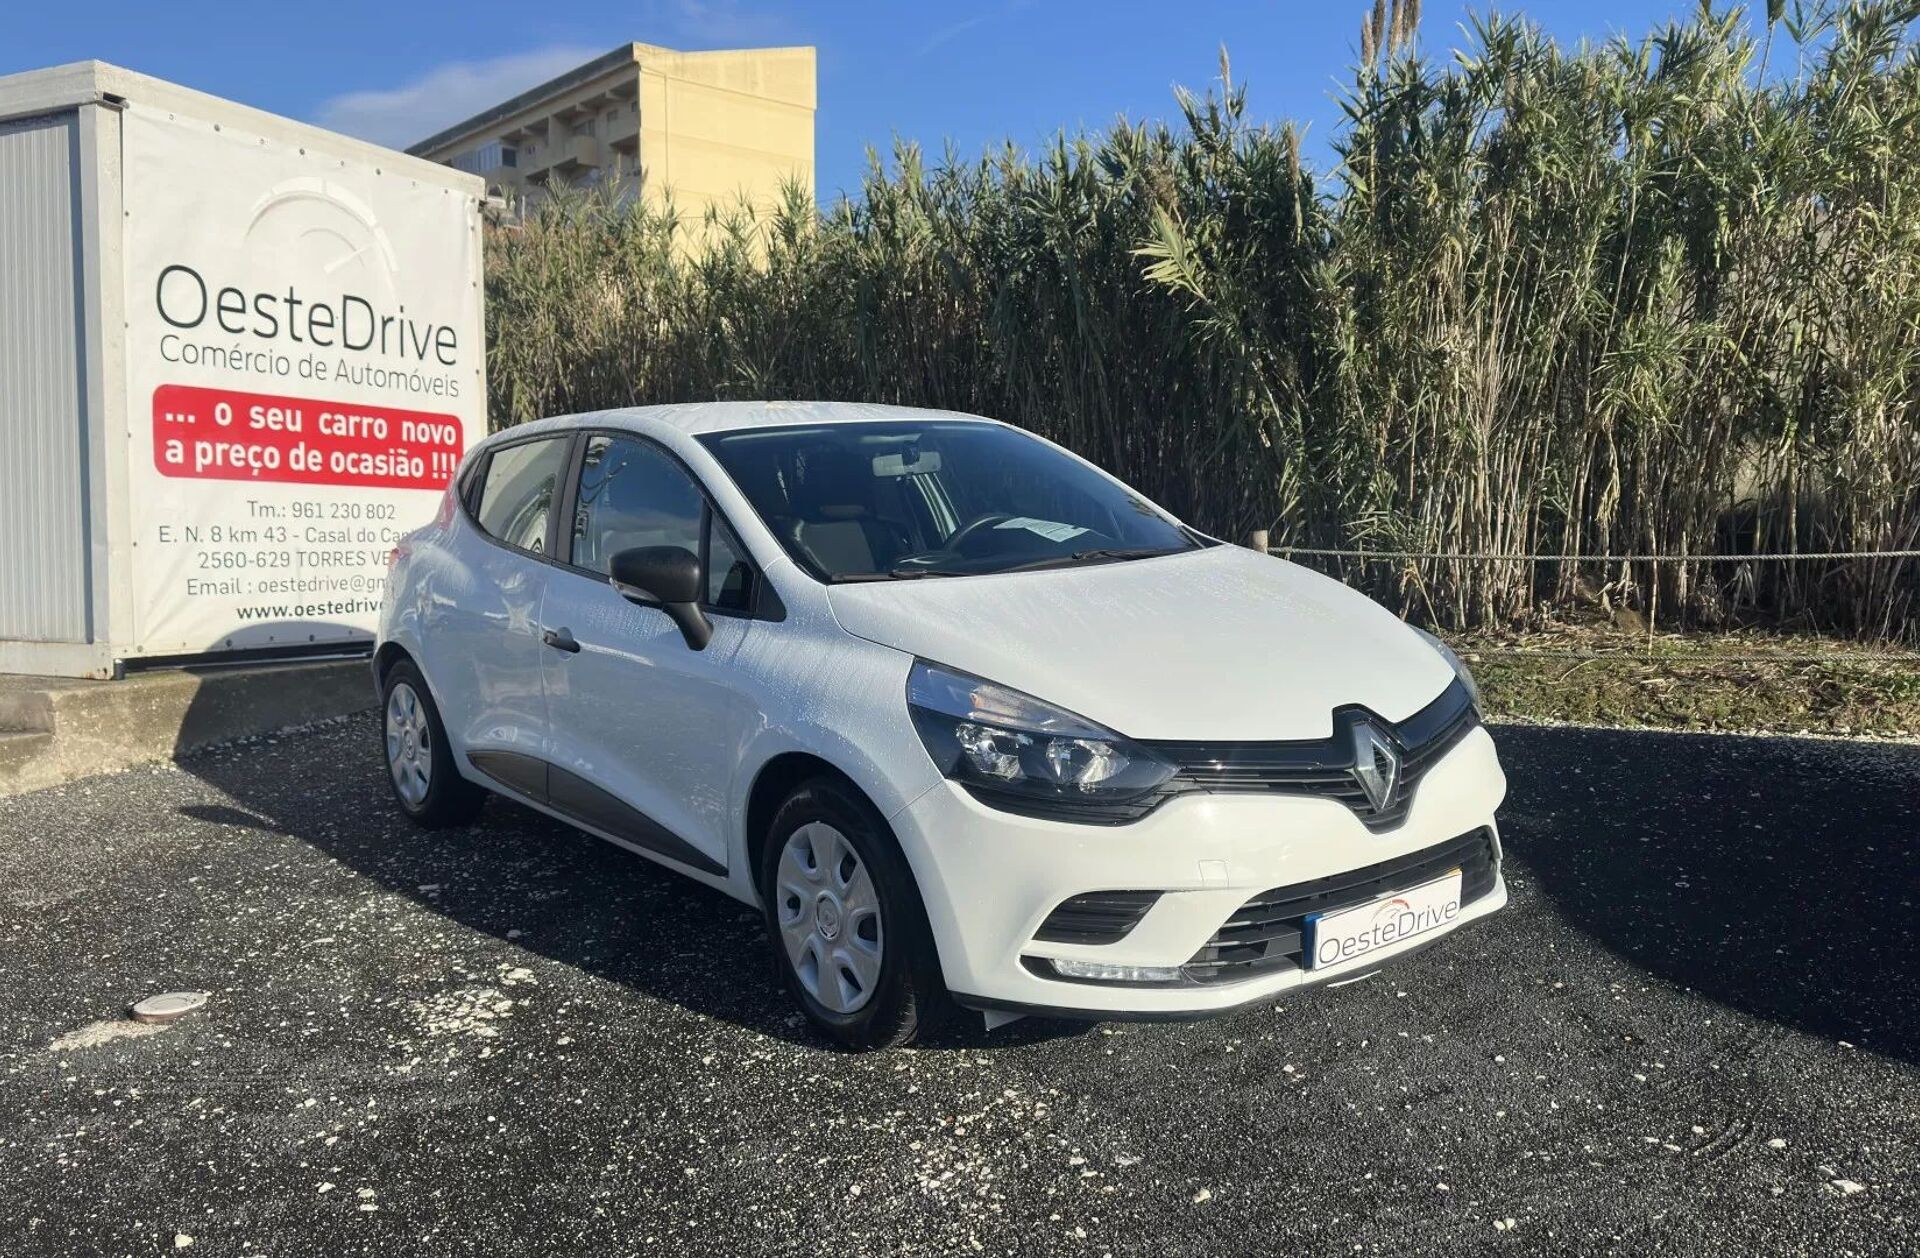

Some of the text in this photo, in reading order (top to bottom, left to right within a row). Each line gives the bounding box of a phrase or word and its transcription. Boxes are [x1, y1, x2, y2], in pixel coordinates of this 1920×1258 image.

[156, 264, 457, 366] OesteDrive
[160, 334, 459, 398] Comércio de Automóveis
[215, 402, 233, 427] o
[250, 405, 302, 432] seu
[319, 411, 388, 440] carro
[402, 421, 457, 446] novo
[165, 440, 184, 464] a
[195, 440, 281, 476] preço
[289, 442, 323, 473] de
[330, 446, 424, 478] ocasião
[247, 500, 396, 520] Tm.: 961 230 802
[159, 525, 178, 543] E.
[185, 525, 204, 543] N.
[210, 525, 222, 543] 8
[229, 526, 257, 543] km
[264, 526, 287, 543] 43
[305, 526, 352, 543] Casal
[357, 527, 376, 543] do
[380, 527, 416, 543] Ca
[198, 551, 290, 569] 2560-629
[297, 551, 366, 568] TORRES
[187, 578, 242, 596] Email
[237, 597, 383, 620] www.oestedriv
[1318, 900, 1458, 964] OesteDrive
